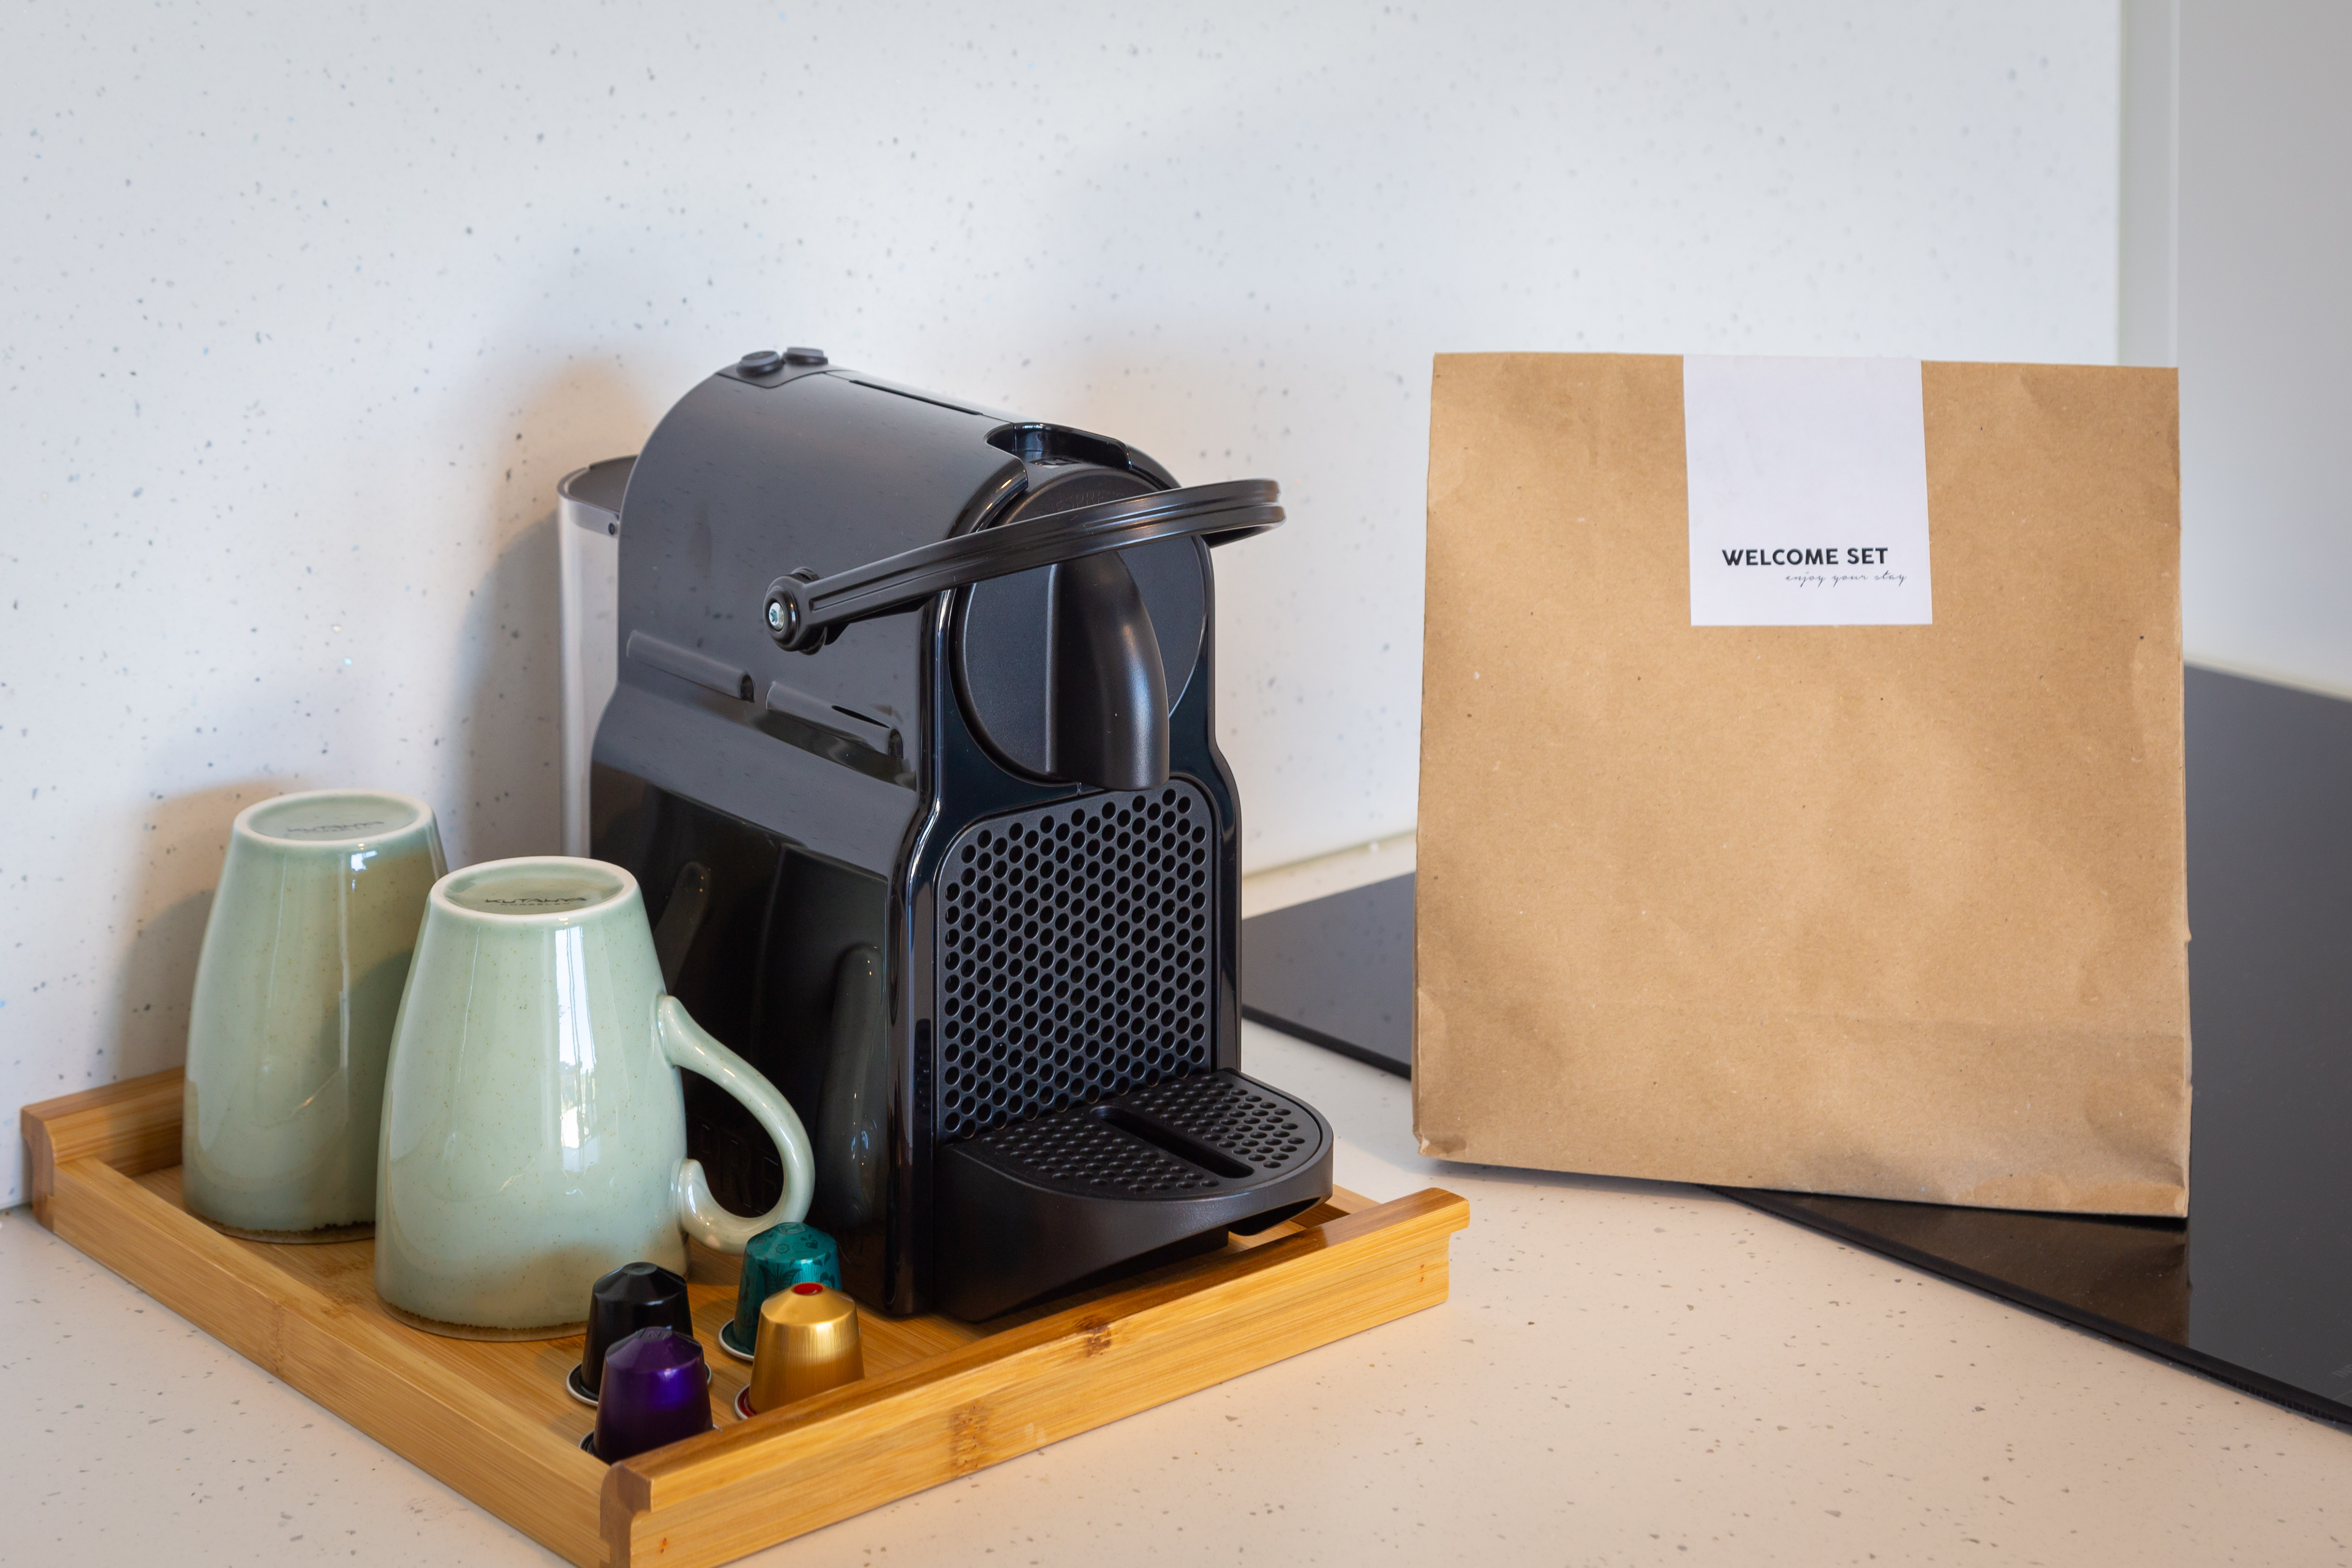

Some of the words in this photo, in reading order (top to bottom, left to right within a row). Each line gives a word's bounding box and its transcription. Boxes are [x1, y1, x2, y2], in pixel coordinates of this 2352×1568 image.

[1722, 548, 1839, 566] WELCOME
[1847, 548, 1888, 564] SET
[1785, 571, 1826, 588] enjoy
[1832, 574, 1868, 587] your
[1874, 570, 1907, 587] stay
